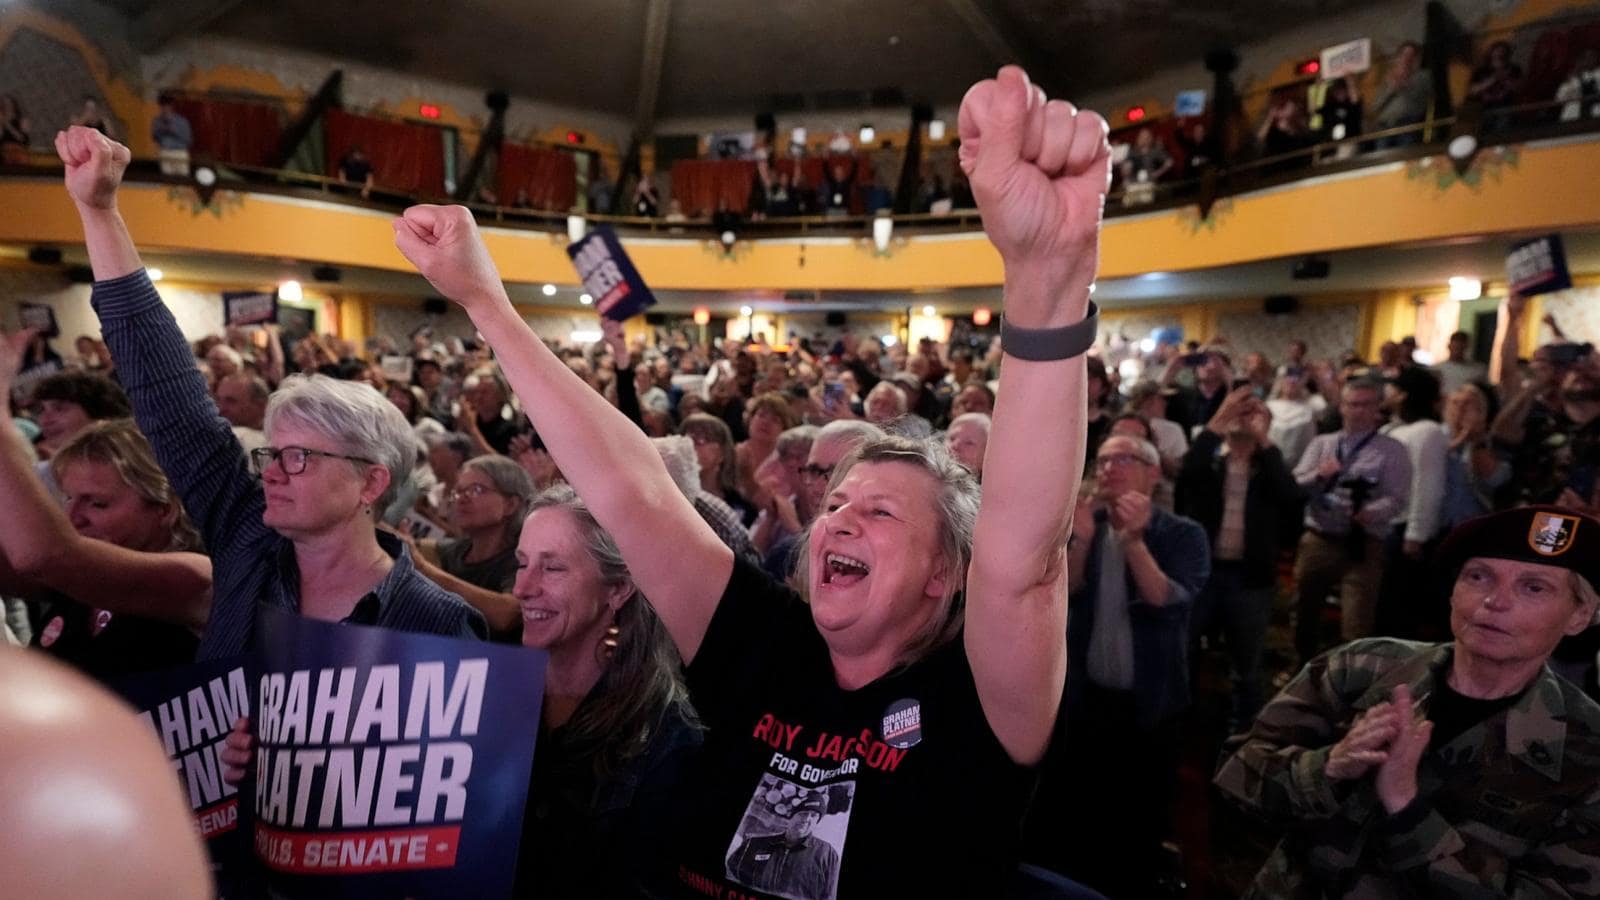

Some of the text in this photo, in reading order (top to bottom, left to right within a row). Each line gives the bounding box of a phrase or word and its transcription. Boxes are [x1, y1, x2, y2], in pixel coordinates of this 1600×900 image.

[258, 658, 488, 744] GRAHAM
[753, 713, 803, 751] ROY
[769, 752, 798, 775] FOR
[255, 741, 473, 828] PLATNER
[303, 835, 428, 868] SENATE
